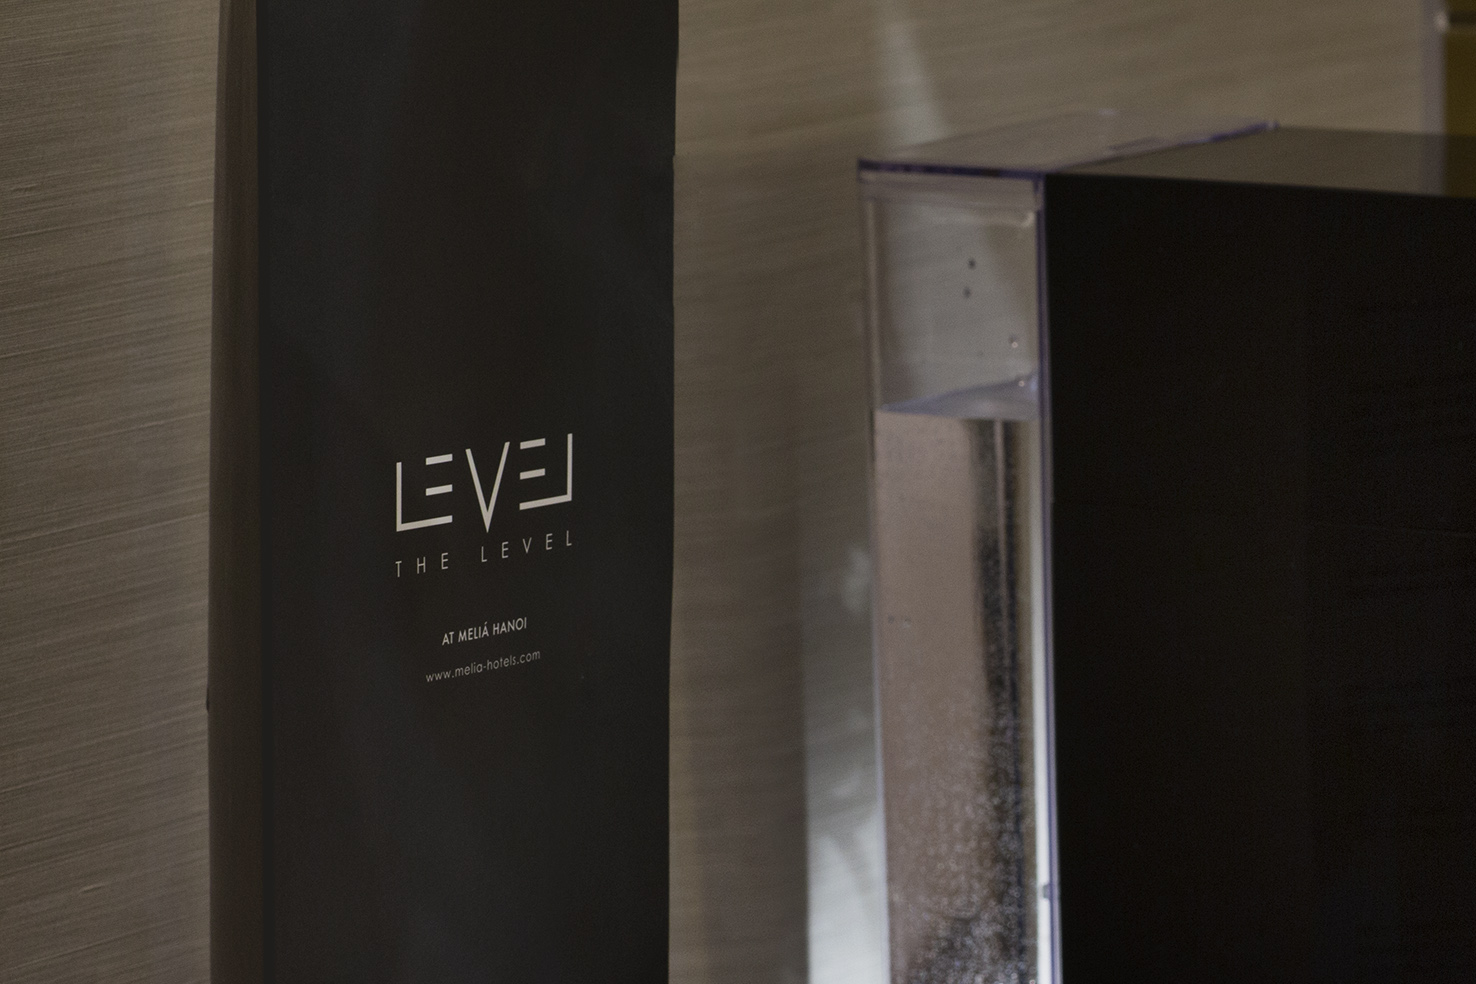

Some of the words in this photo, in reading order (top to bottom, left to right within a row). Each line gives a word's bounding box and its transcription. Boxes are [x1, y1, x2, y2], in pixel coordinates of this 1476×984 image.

[396, 433, 573, 533] LEVEL
[395, 552, 449, 578] THE
[480, 530, 573, 563] LEVEL
[441, 631, 455, 646] AT
[457, 621, 490, 643] MELIÁ
[492, 617, 528, 636] HANOI
[425, 650, 541, 682] www.melia-hotels.com
